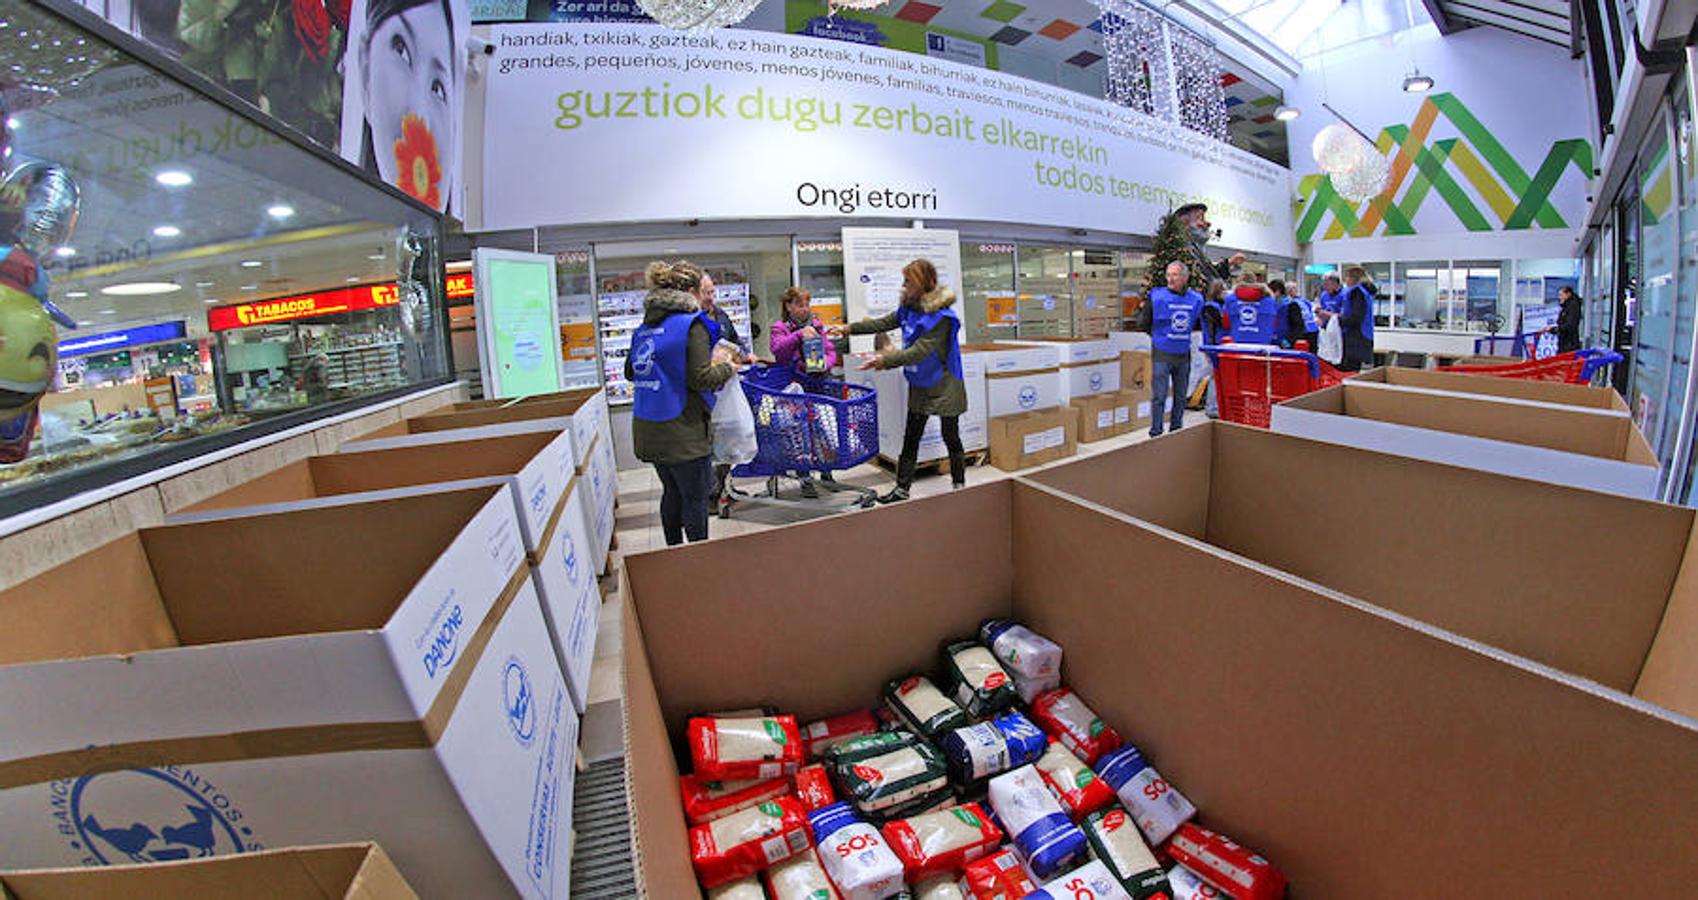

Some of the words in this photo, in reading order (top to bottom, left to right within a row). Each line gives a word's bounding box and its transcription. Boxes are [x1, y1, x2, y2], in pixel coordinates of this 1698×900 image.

[609, 0, 630, 13] da
[500, 32, 579, 47] handiak,
[584, 31, 646, 48] txikiak,
[650, 34, 723, 50] gazteak,
[727, 40, 747, 51] ez
[750, 37, 787, 54] hain
[789, 45, 856, 63] gazteak,
[859, 51, 918, 74] familiak,
[500, 54, 580, 73] grandes,
[584, 52, 681, 71] pequeños,
[684, 53, 758, 73] jóvenes,
[761, 62, 819, 78] menos
[820, 67, 885, 88] jóvenes,
[886, 74, 944, 97] familias,
[555, 82, 726, 130] guztiok
[738, 87, 842, 132] dugu
[852, 103, 975, 142] zerbait
[982, 117, 1109, 167] elkarrekin
[796, 182, 861, 214] Ongi
[867, 187, 938, 211] etorri
[1035, 160, 1106, 196] todos
[1110, 177, 1188, 209] tenemos
[256, 298, 315, 317] TABACOS
[836, 833, 878, 858] SOS
